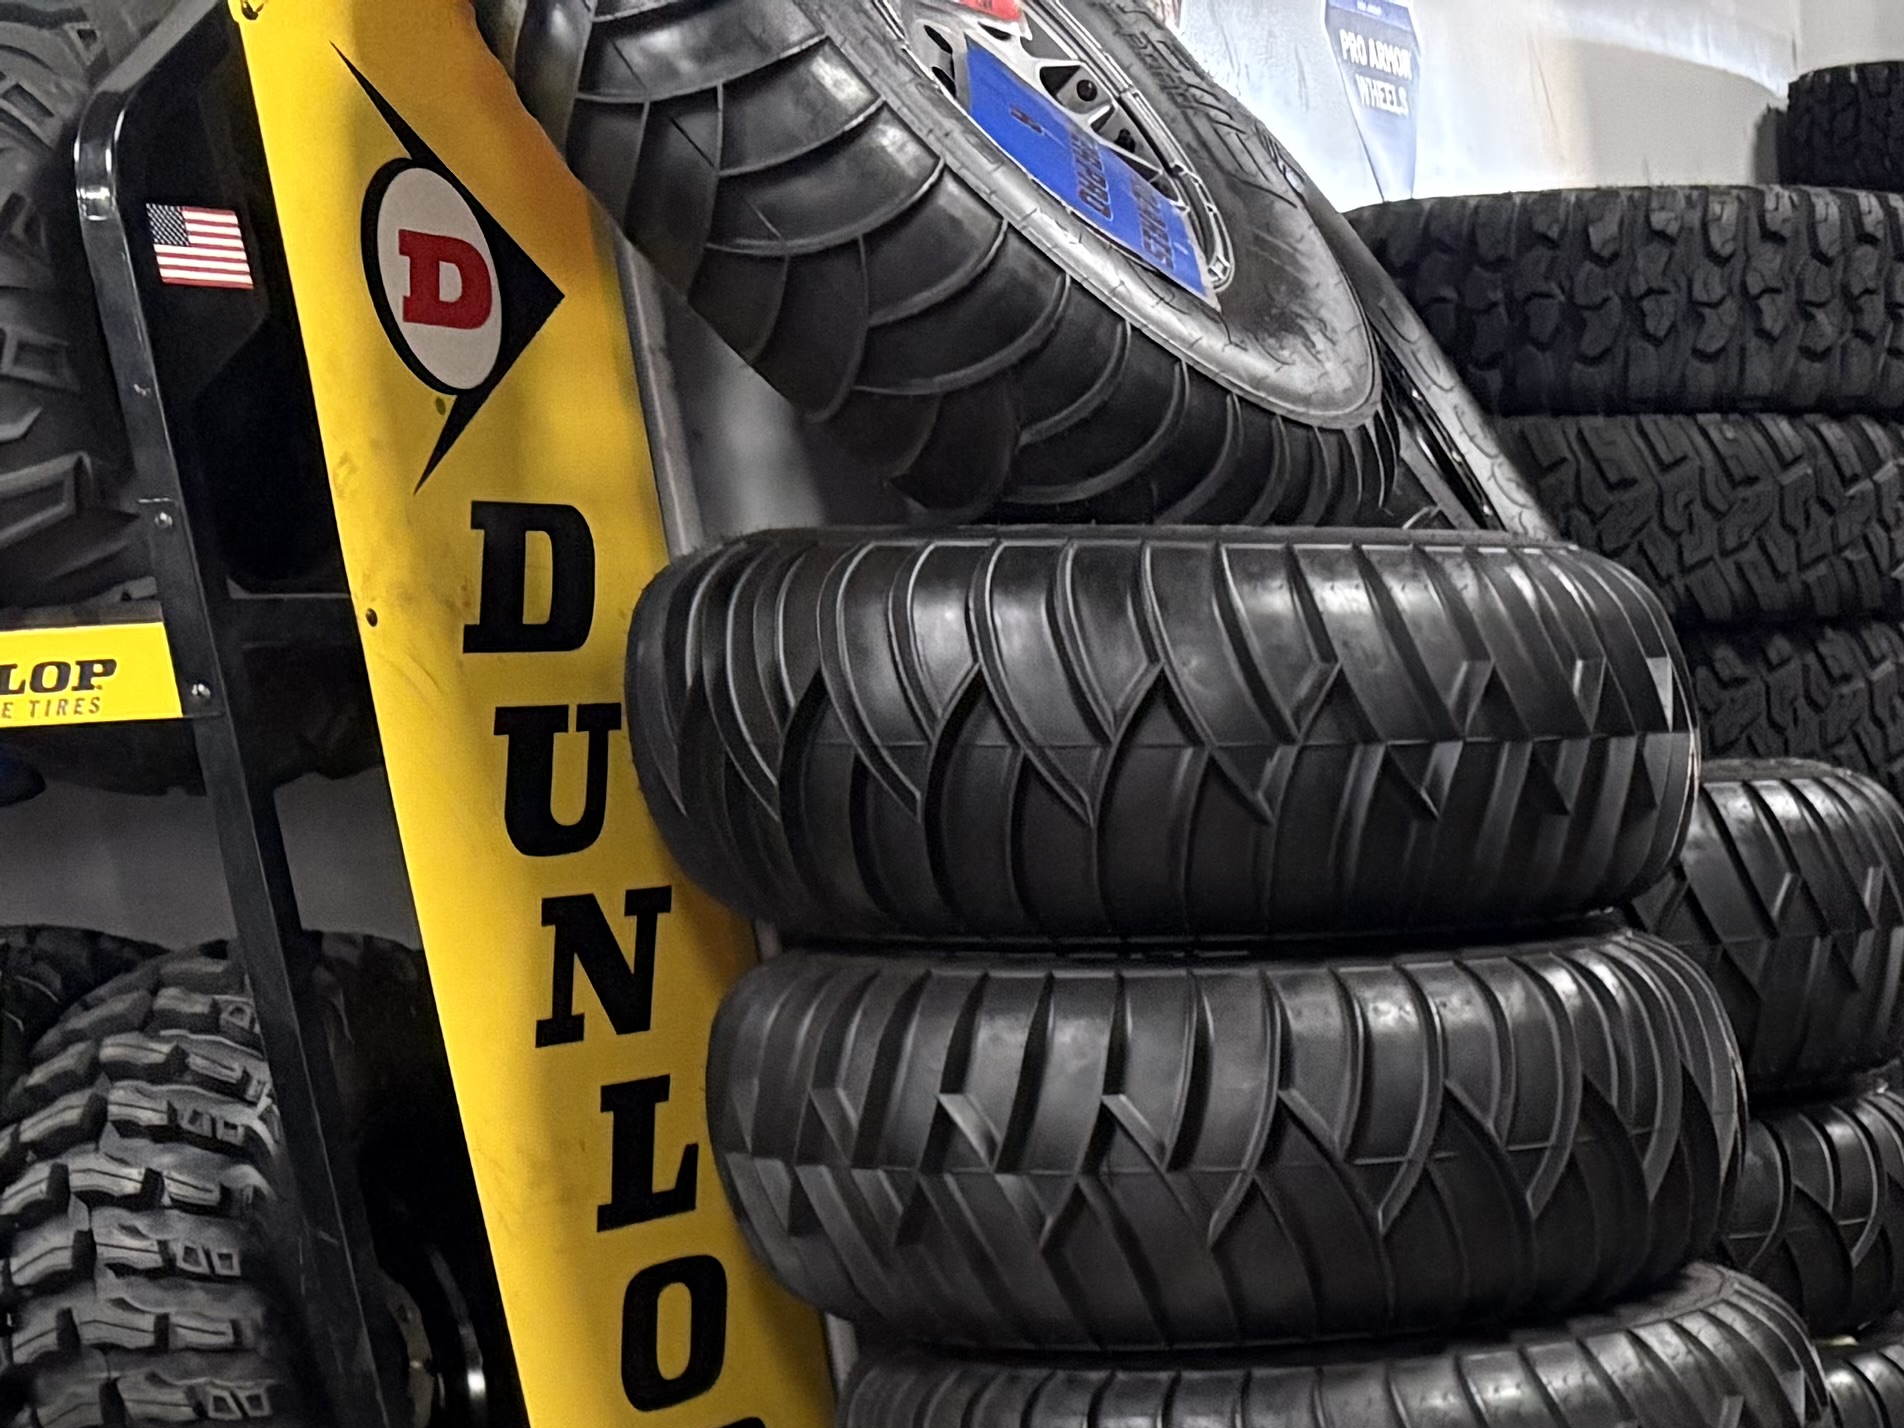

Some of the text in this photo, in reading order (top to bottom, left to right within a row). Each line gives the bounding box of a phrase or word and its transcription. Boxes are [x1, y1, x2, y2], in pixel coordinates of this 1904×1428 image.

[1338, 28, 1413, 80] PRO ARMOR
[1355, 73, 1409, 117] WHEELS
[398, 228, 493, 330] D
[30, 696, 101, 719] TIRES
